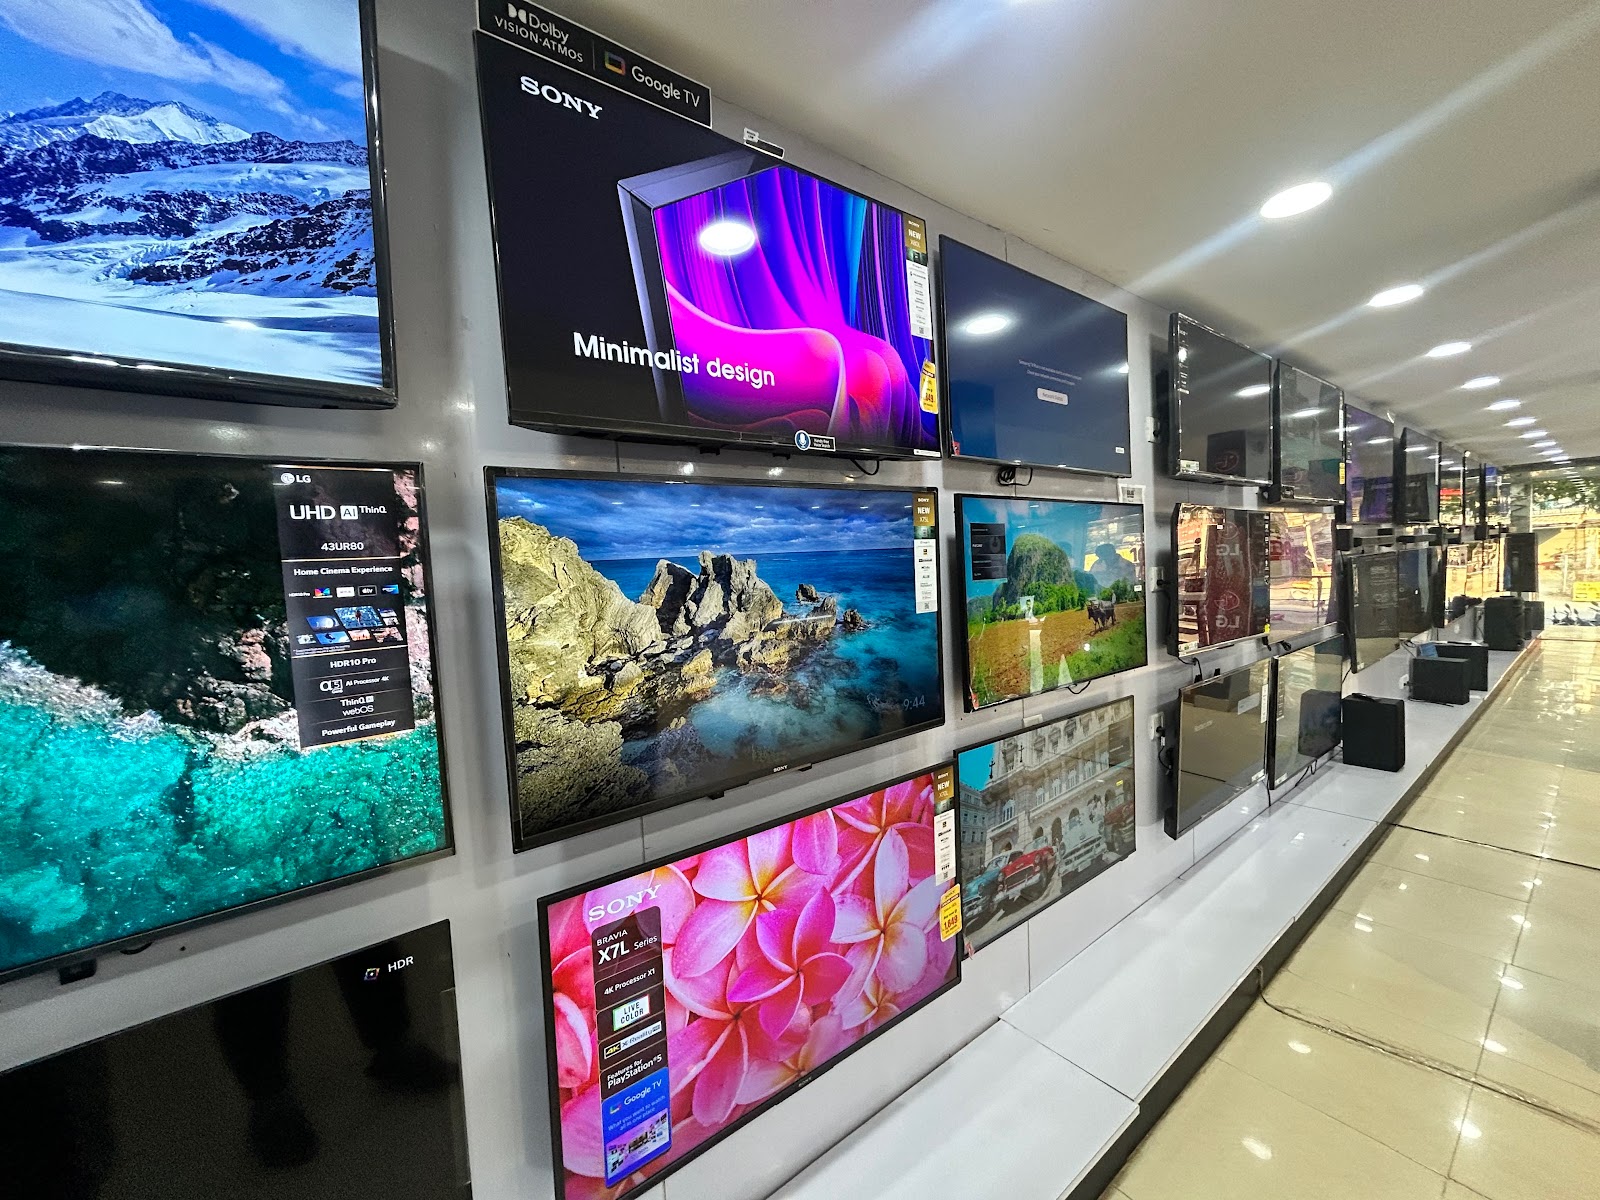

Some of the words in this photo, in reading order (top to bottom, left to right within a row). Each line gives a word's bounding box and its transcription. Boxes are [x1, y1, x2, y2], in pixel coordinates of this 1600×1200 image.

[528, 12, 569, 44] Dolby
[631, 65, 681, 100] Google
[682, 89, 700, 108] TV
[520, 75, 603, 120] SONY
[908, 229, 921, 240] NEW
[573, 331, 700, 374] Minimalist
[706, 357, 776, 389] design
[296, 474, 312, 483] LG
[289, 504, 336, 520] UHD
[341, 506, 357, 518] AI
[359, 505, 387, 514] ThinQ
[917, 506, 930, 514] NEW
[320, 542, 365, 551] 43UR80
[293, 568, 319, 576] Home
[320, 567, 350, 575] Cinema
[351, 565, 393, 575] Experience
[330, 658, 361, 668] HDR10
[362, 657, 377, 665] Pro
[353, 677, 380, 685] Processor
[340, 696, 366, 706] ThinQ
[903, 694, 925, 711] 9:44
[342, 705, 374, 716] webOS
[321, 724, 358, 737] Powerful
[358, 719, 396, 731] Gameplay
[773, 764, 788, 773] SONY
[937, 780, 950, 791] NEW
[588, 884, 662, 922] SONY
[596, 929, 628, 946] BRAVIA
[598, 941, 630, 965] X7L
[633, 935, 658, 950] Series
[388, 956, 414, 972] HDR
[604, 987, 614, 995] 4K
[614, 973, 647, 991] Processor
[647, 968, 656, 977] X1
[623, 1002, 641, 1015] LIVE
[620, 1009, 644, 1025] COLOR
[606, 1044, 620, 1055] 4K
[607, 1064, 633, 1081] Features
[634, 1059, 643, 1067] for
[624, 1087, 651, 1105] Google
[652, 1079, 662, 1090] TV
[608, 1121, 621, 1131] What
[622, 1114, 633, 1124] you
[632, 1107, 645, 1118] want
[651, 1095, 666, 1107] watch
[632, 1117, 642, 1127] one
[642, 1107, 655, 1120] place
